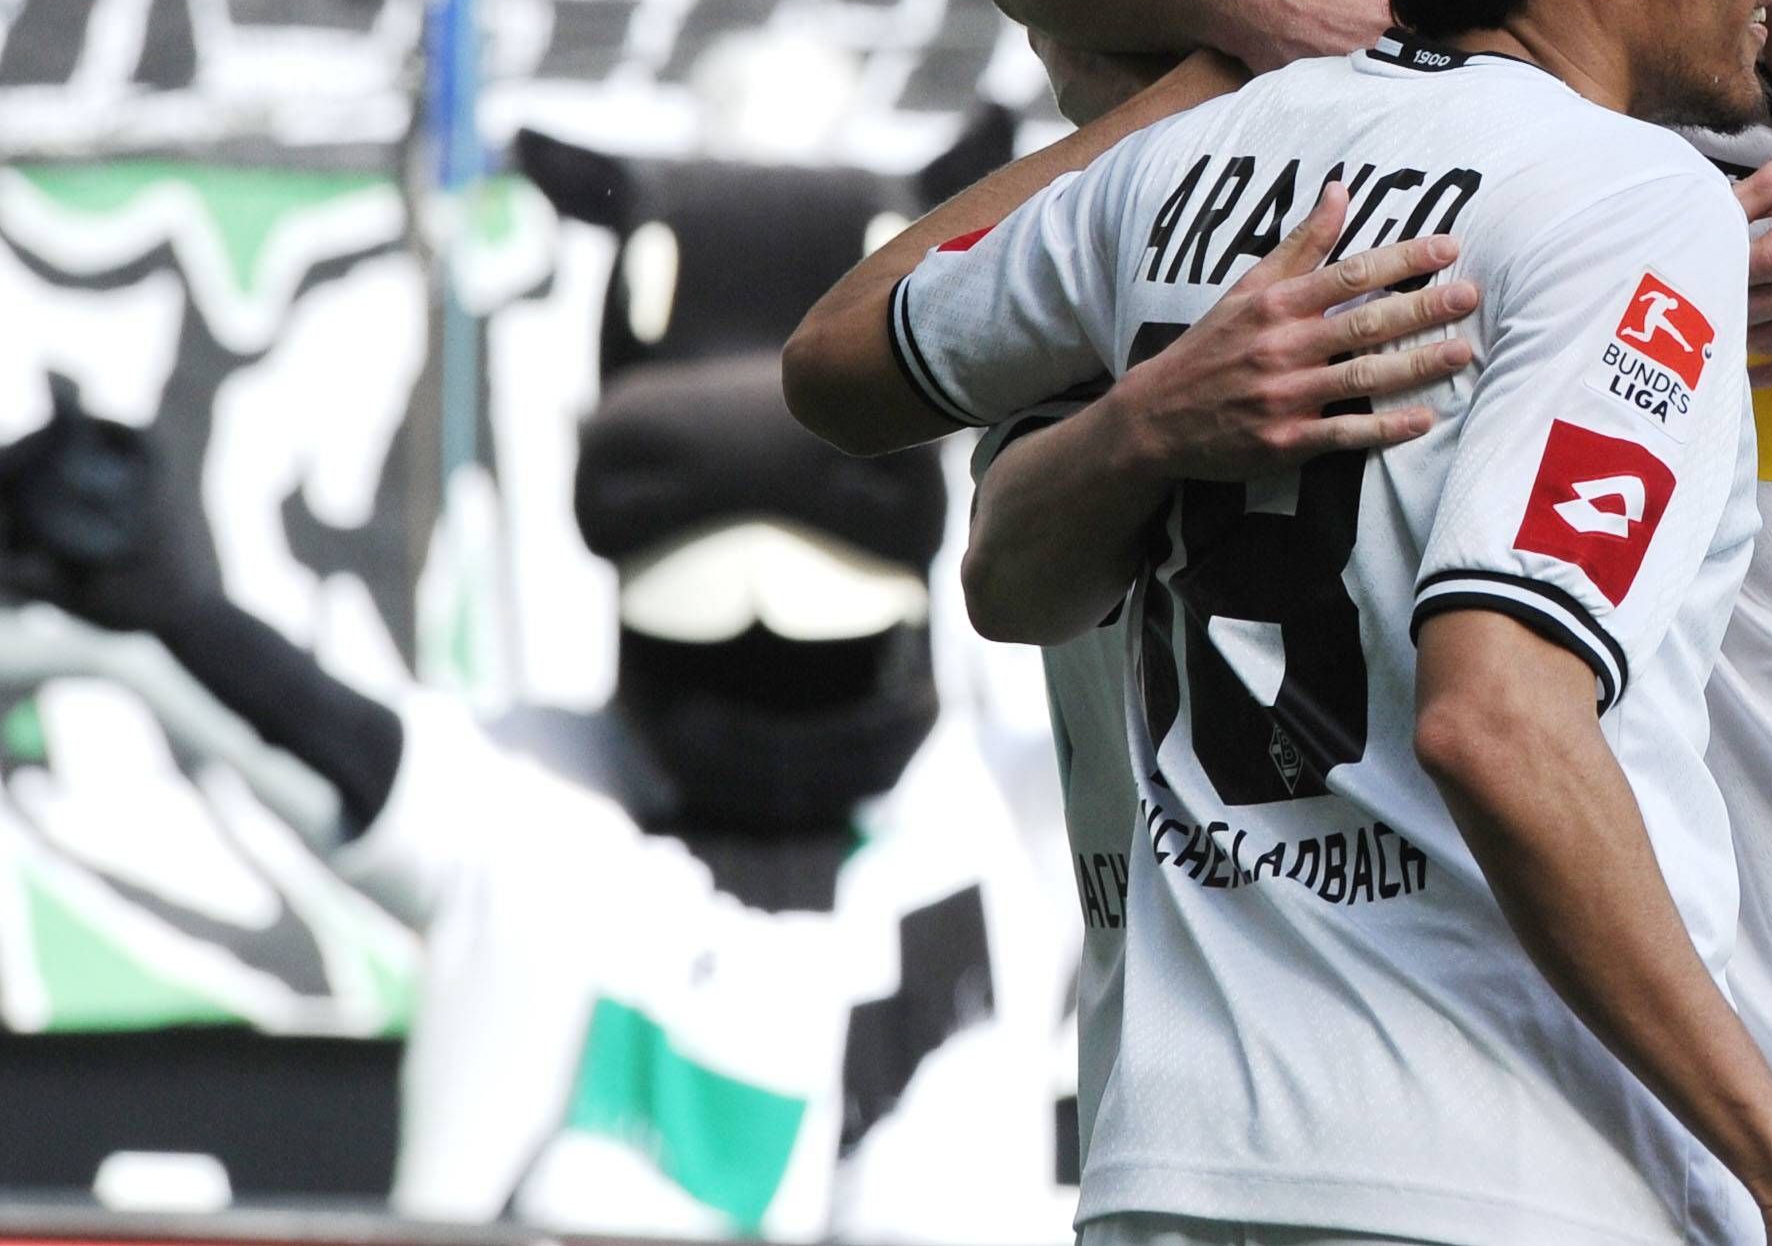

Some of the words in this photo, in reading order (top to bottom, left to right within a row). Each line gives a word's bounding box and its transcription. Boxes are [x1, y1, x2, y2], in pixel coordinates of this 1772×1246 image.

[1413, 49, 1452, 67] 1900
[1602, 343, 1690, 414] BUNDES
[1609, 375, 1668, 424] LIGA
